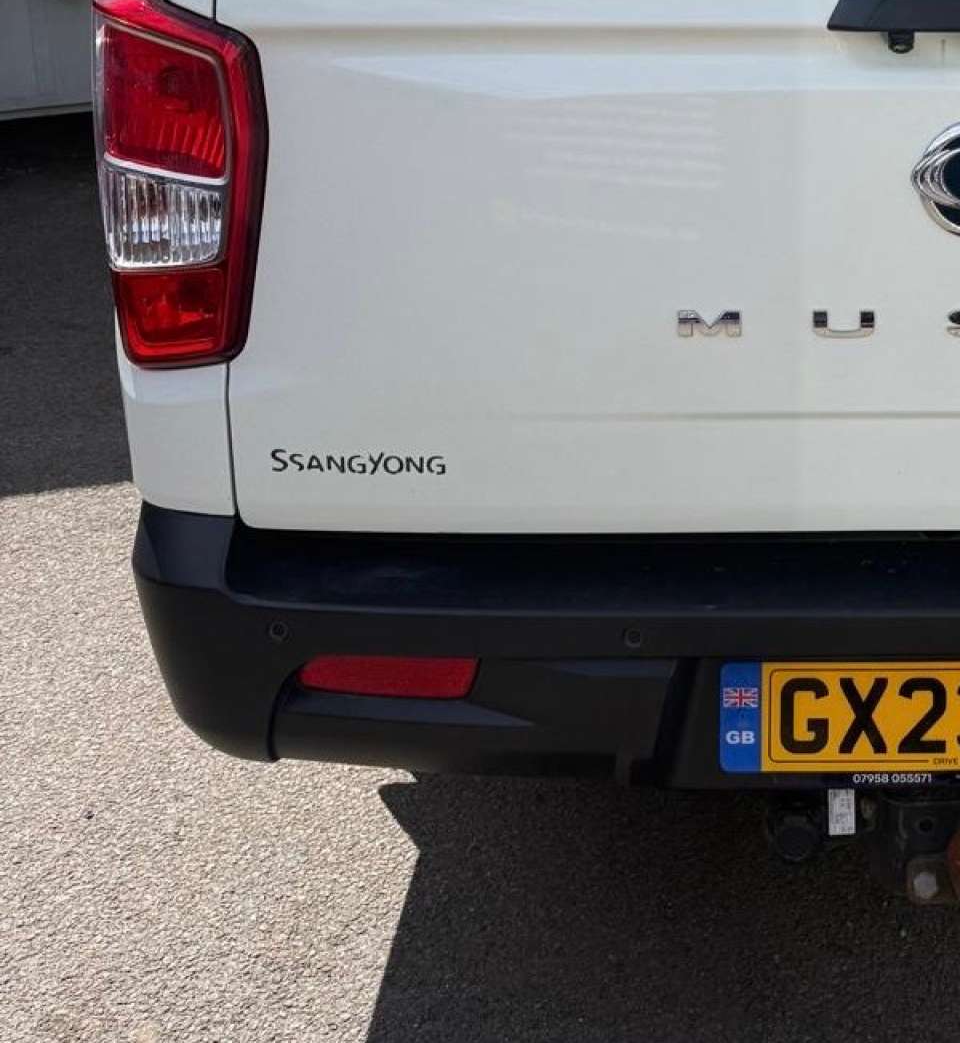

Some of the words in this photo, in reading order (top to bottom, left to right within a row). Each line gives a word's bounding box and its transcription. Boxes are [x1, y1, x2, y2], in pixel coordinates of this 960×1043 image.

[725, 730, 756, 745] GB
[932, 757, 958, 765] DRIVE
[852, 773, 889, 784] 07958
[891, 773, 932, 784] 055571
